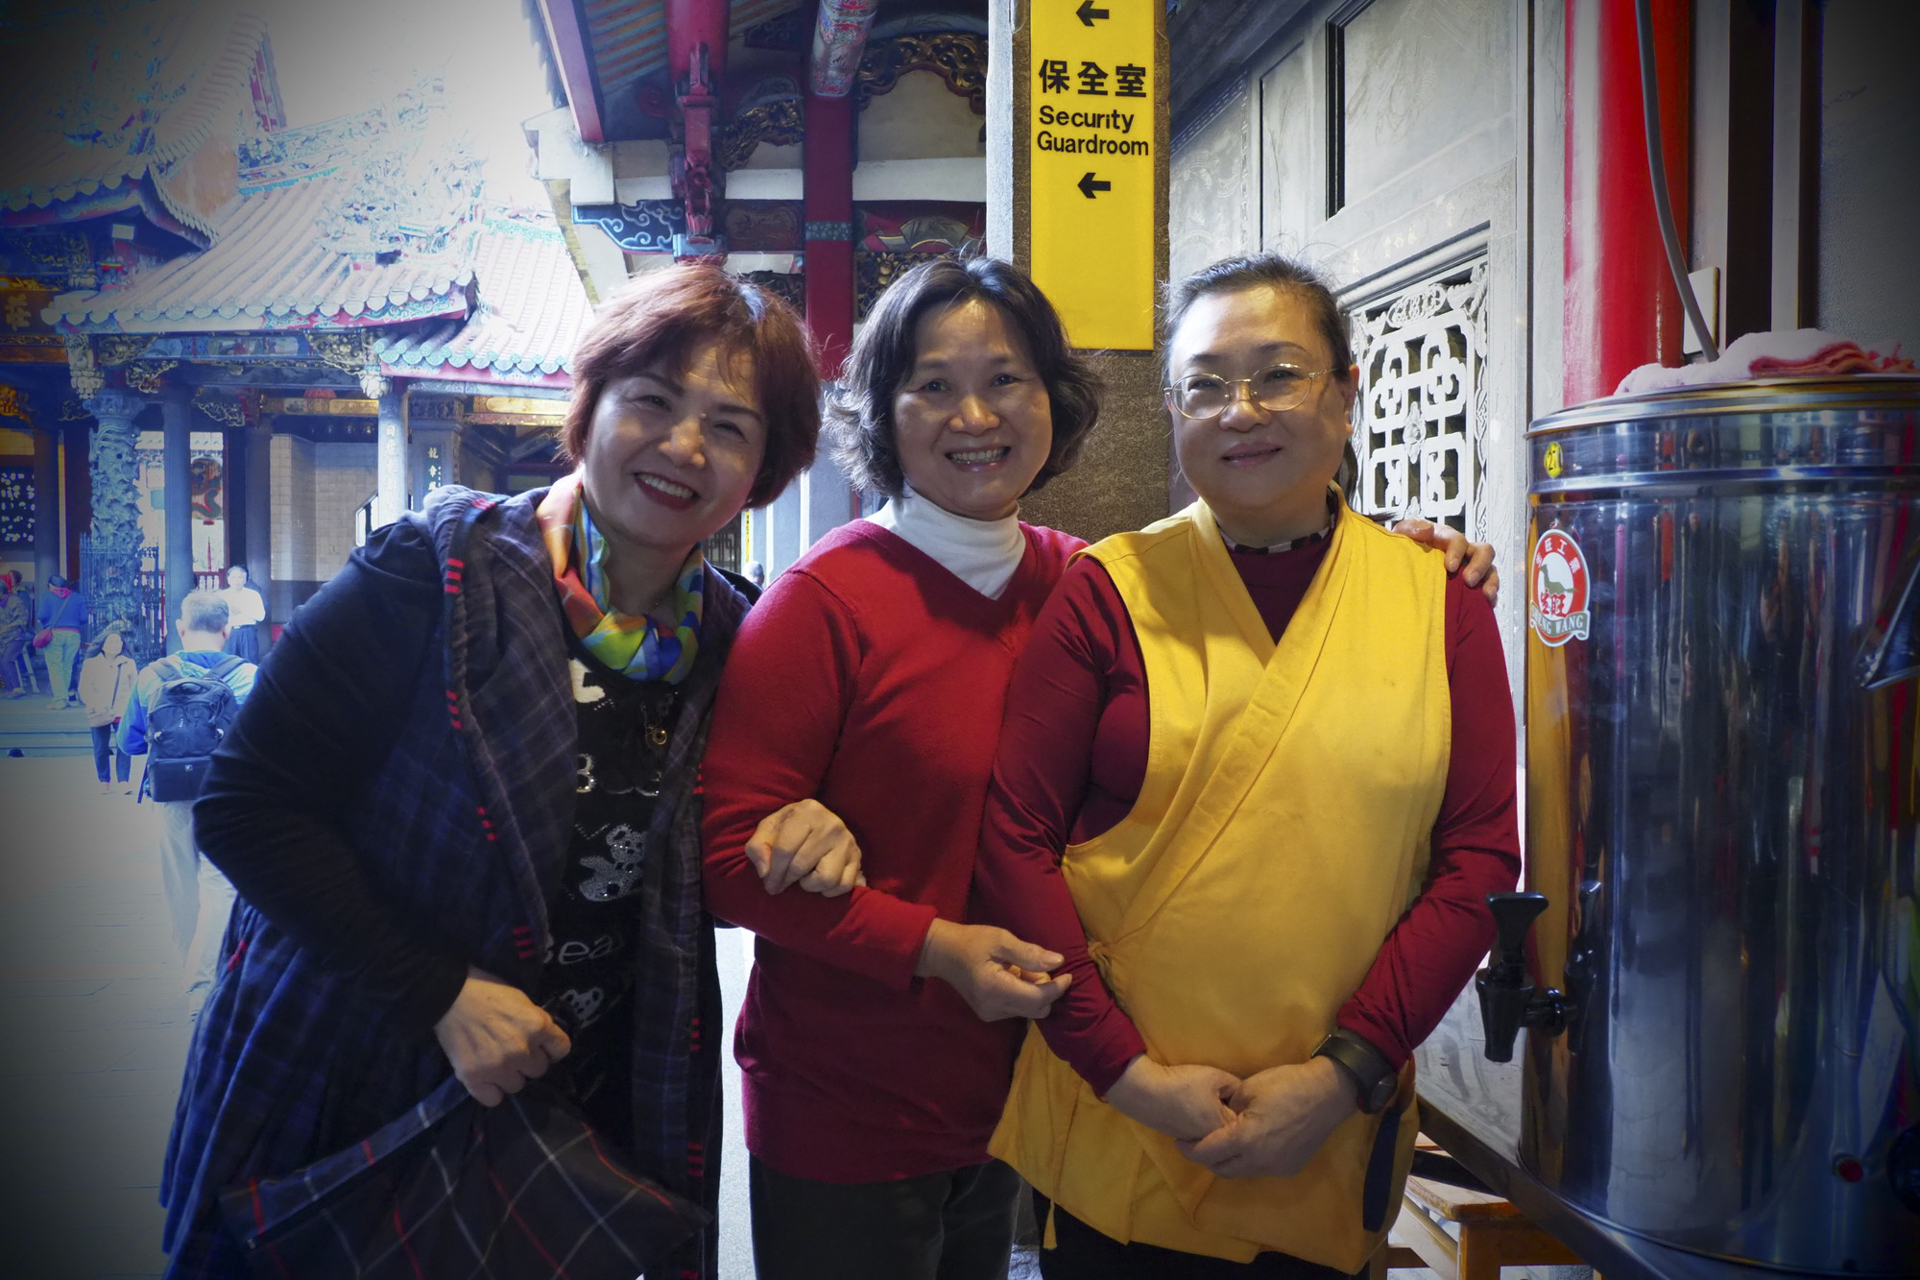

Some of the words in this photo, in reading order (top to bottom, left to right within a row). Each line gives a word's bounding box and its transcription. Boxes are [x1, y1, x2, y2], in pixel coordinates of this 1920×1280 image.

[1038, 59, 1147, 97] 保全室
[1038, 105, 1135, 134] Security
[1037, 131, 1149, 156] Guardroom
[1556, 614, 1583, 634] WANG
